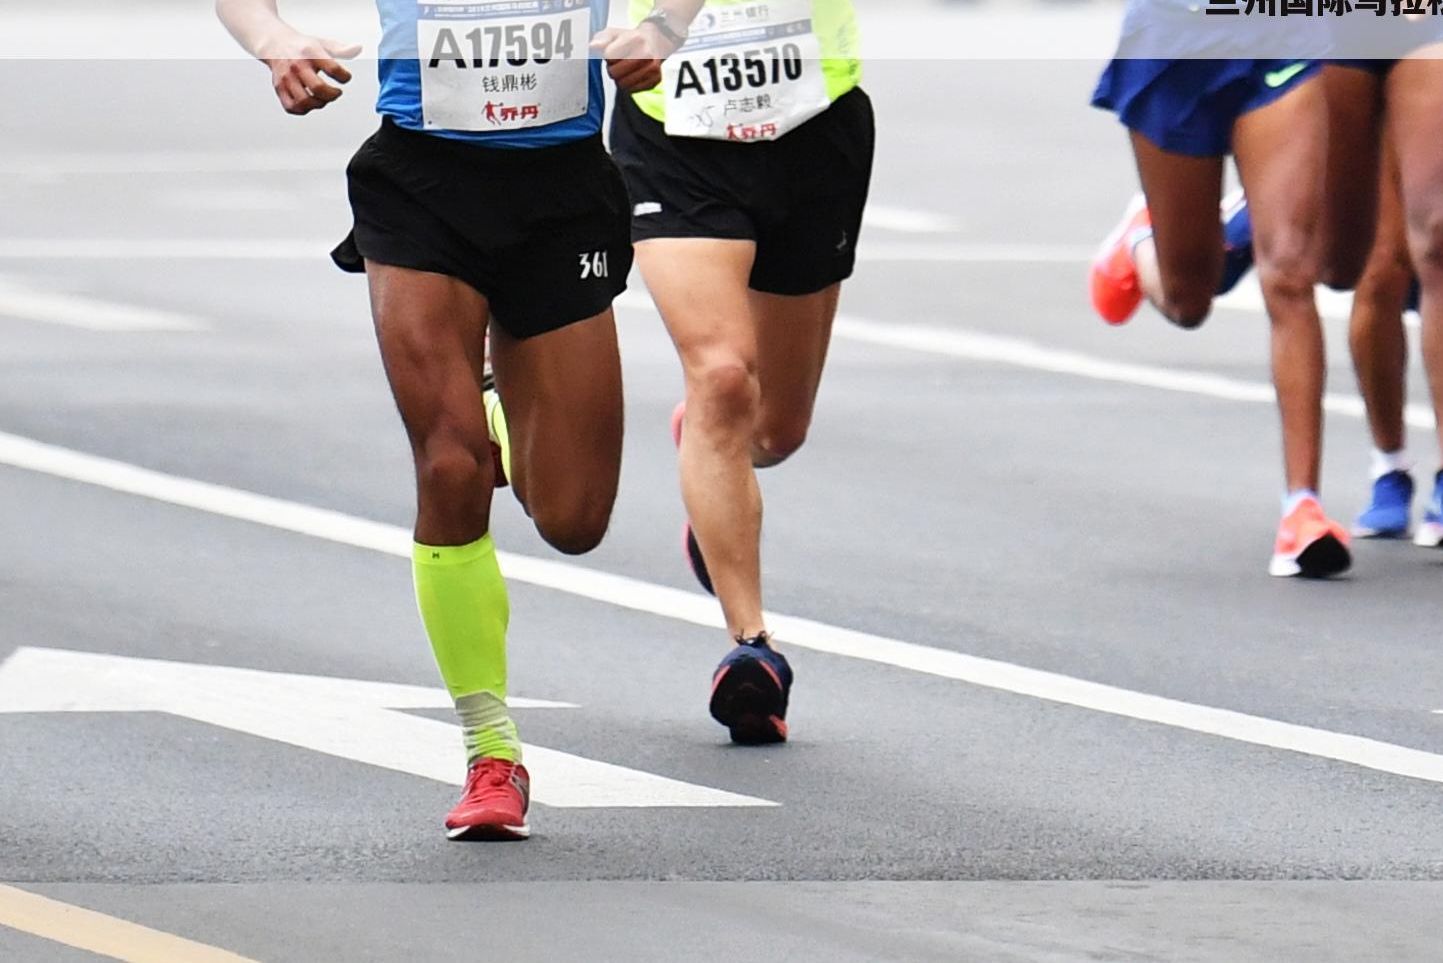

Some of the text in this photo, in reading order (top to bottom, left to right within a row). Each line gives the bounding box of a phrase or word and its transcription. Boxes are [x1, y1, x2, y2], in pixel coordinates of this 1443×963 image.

[428, 18, 574, 69] A17594
[482, 72, 538, 93] 钱鼎彬
[674, 42, 803, 99] A13570
[723, 93, 773, 116] 卢志毅
[578, 250, 609, 279] 361
